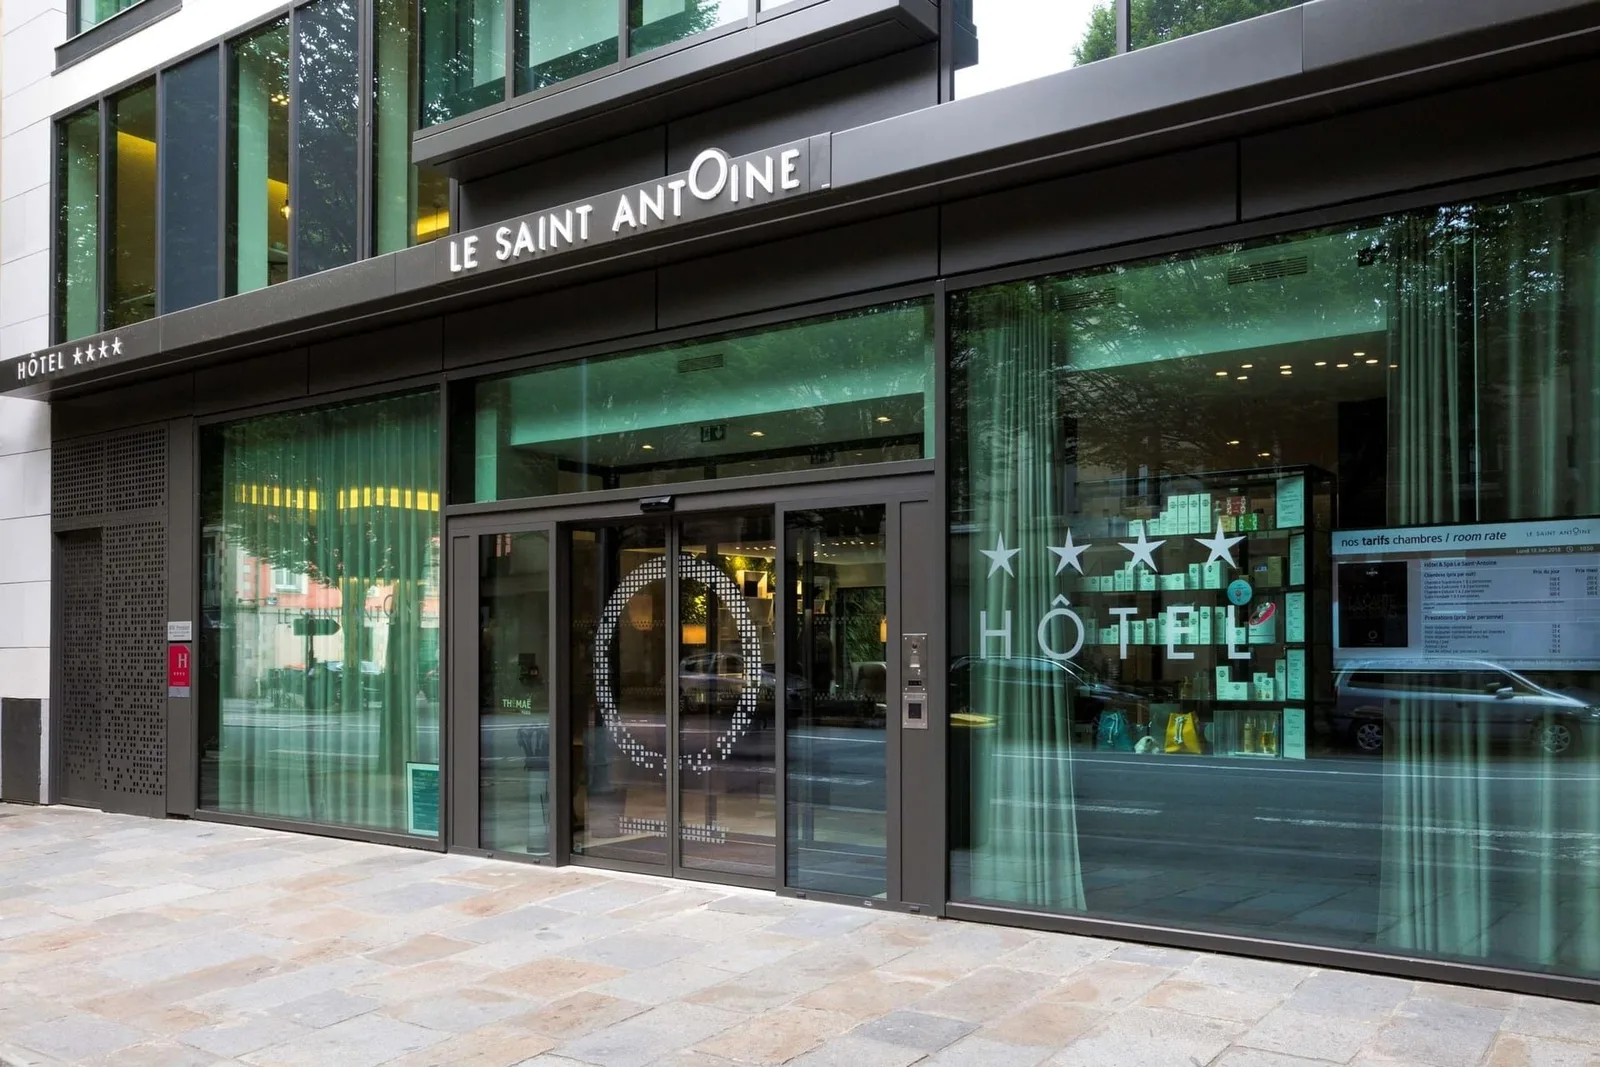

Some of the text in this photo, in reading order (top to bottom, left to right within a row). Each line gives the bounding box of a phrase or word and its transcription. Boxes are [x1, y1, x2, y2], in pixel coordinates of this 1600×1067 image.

[450, 148, 801, 273] LE SAINT ANTOINE
[17, 352, 65, 380] HÔTEL
[1341, 531, 1507, 548] nos tarifs chambres / room rate
[1559, 526, 1591, 536] ANTOINE
[1443, 561, 1454, 569] Spa
[979, 593, 1252, 660] HÔTEL
[177, 653, 188, 669] H
